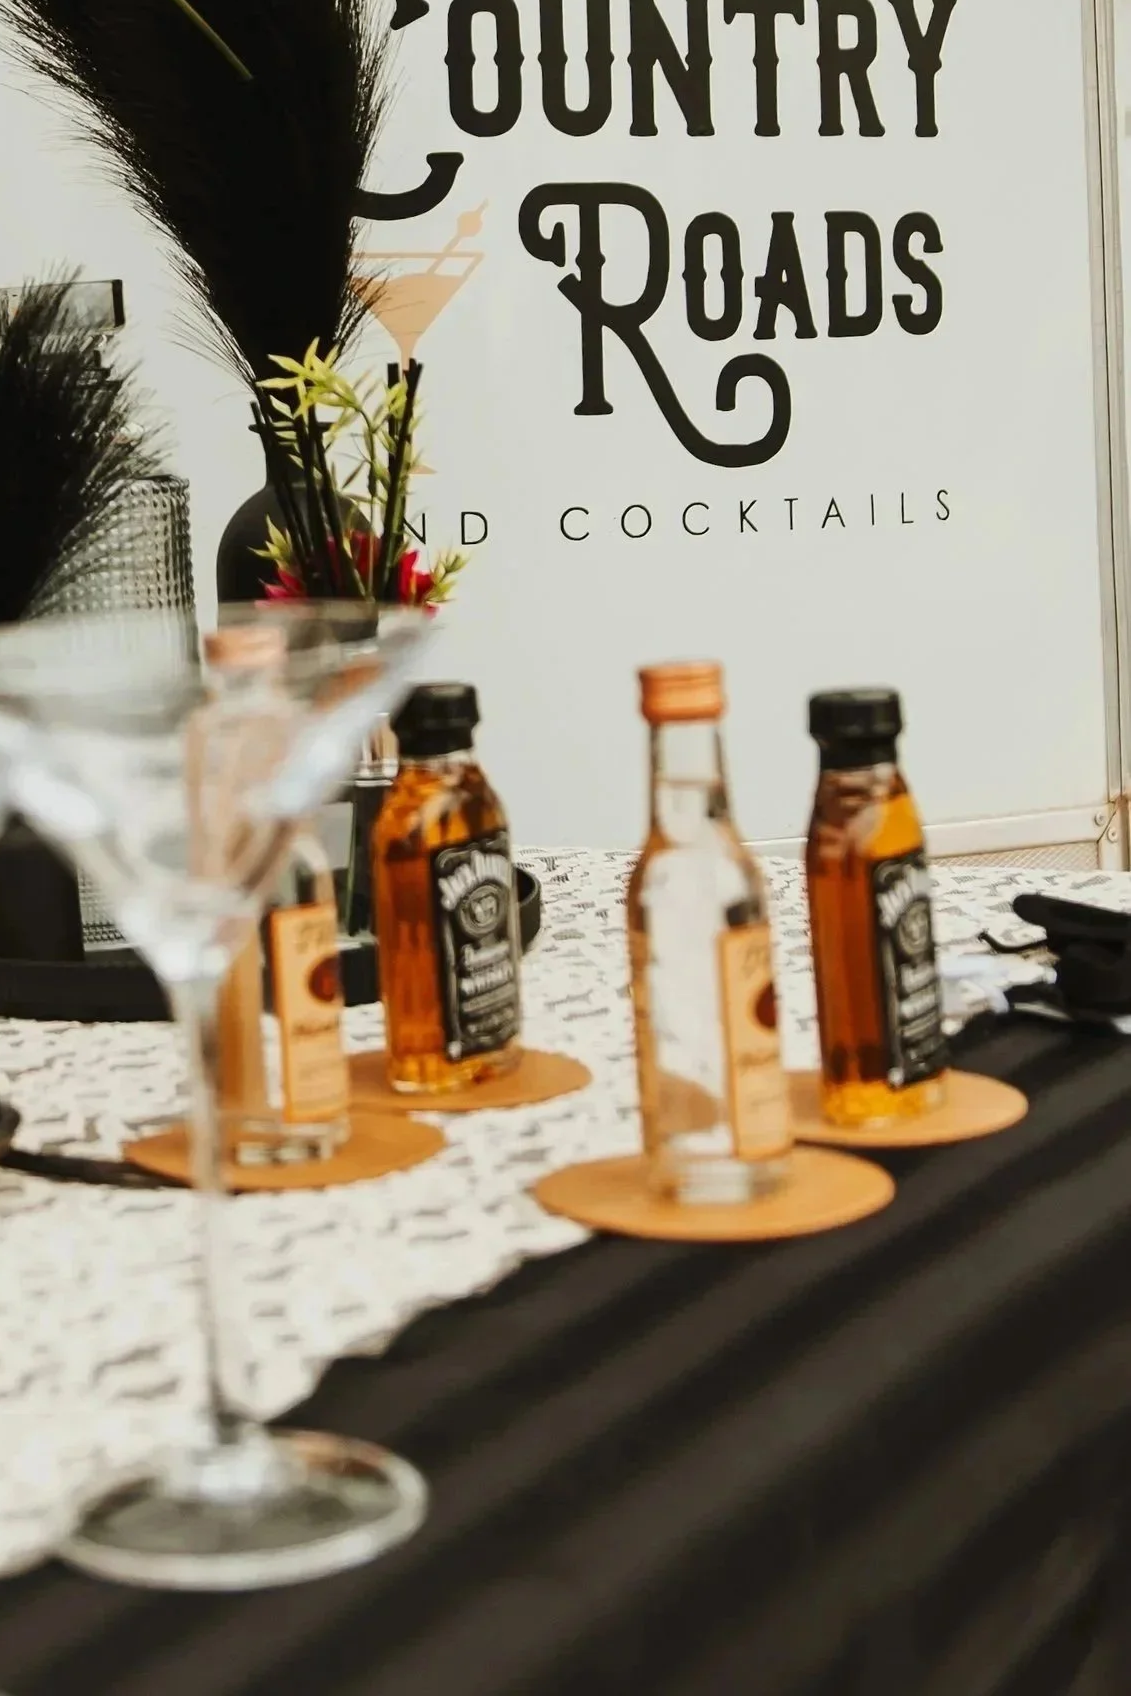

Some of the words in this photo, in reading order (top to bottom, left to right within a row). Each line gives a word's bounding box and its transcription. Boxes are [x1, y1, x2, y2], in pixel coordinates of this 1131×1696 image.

[519, 183, 944, 469] ROADS
[403, 512, 489, 546] ND
[560, 489, 950, 542] COCKTAILS
